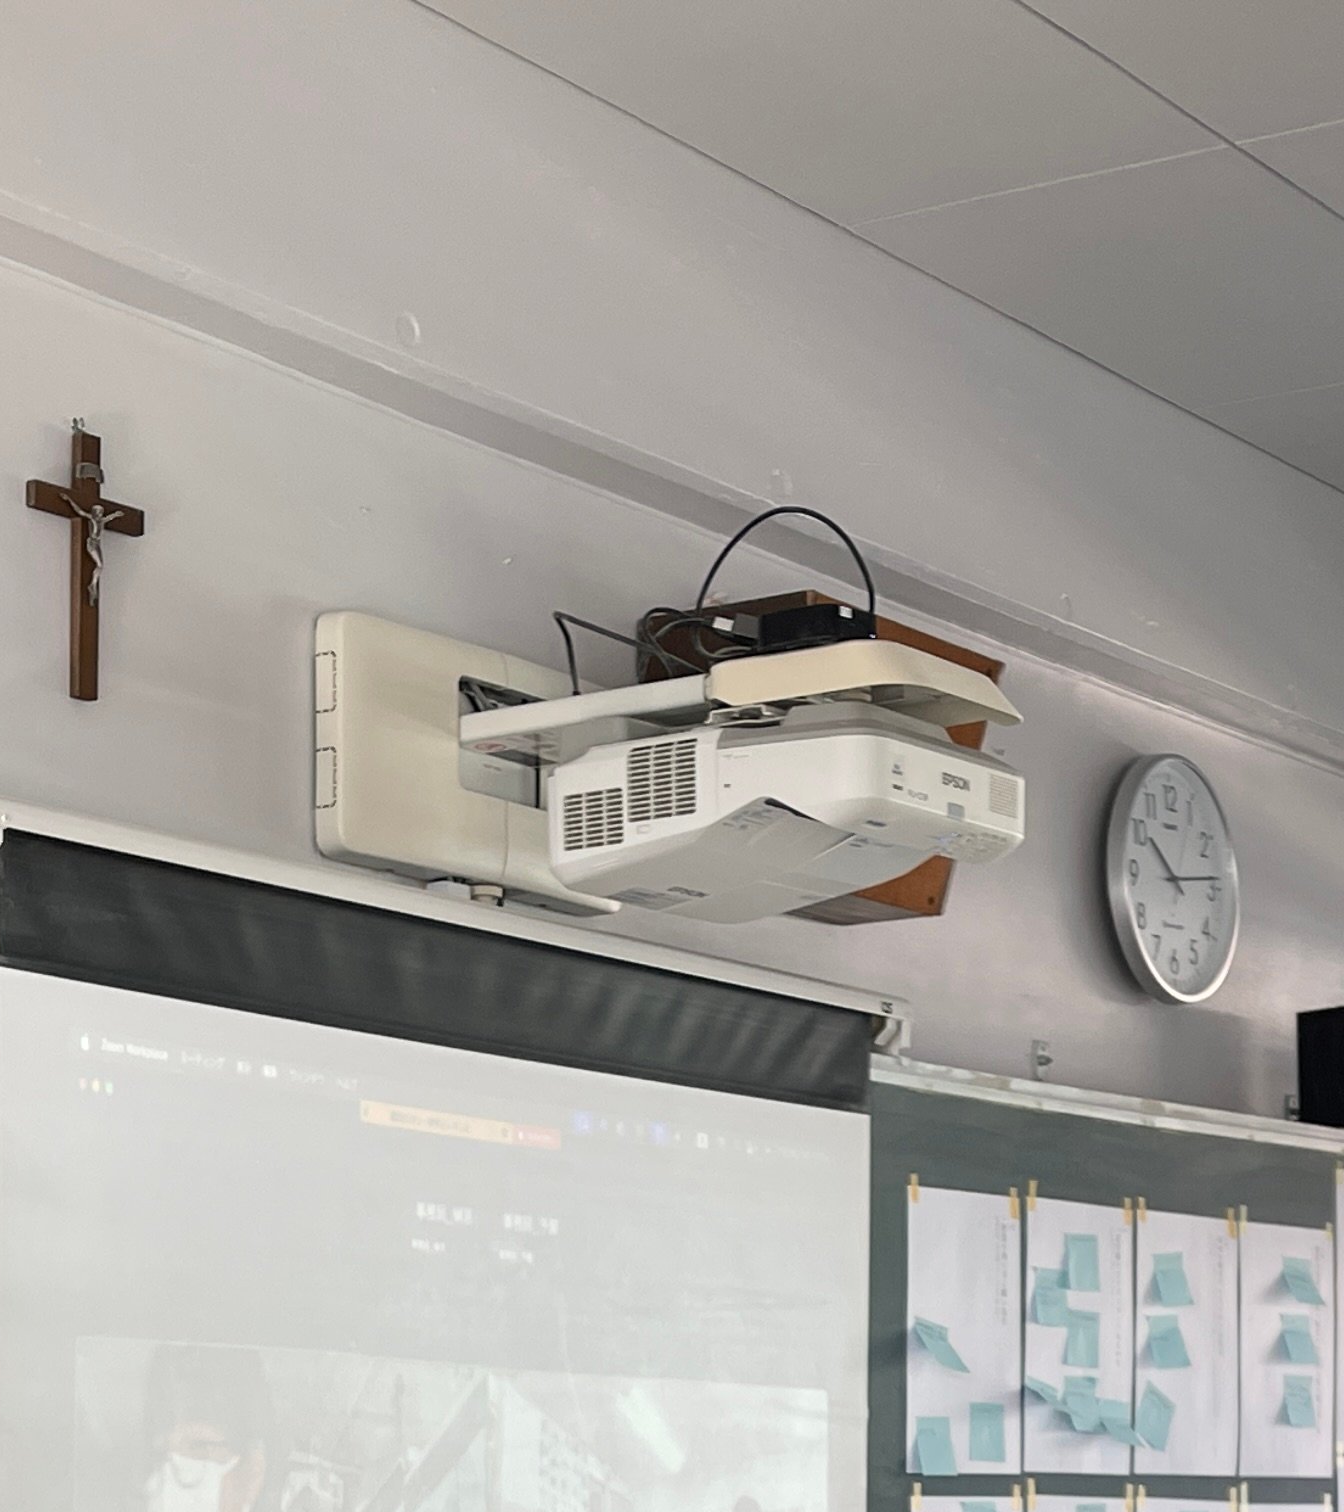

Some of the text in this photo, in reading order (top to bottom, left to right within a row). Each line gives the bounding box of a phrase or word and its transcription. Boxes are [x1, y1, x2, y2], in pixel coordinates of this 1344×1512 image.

[941, 771, 971, 793] EPSON
[1144, 791, 1158, 820] 11
[1162, 783, 1179, 813] 12
[1131, 818, 1148, 846] 10
[1199, 831, 1213, 859] 2
[1129, 858, 1140, 886] 9
[1136, 902, 1147, 930] 8
[1151, 934, 1161, 962] 7
[1169, 947, 1180, 975] 6
[1190, 938, 1199, 966] 5
